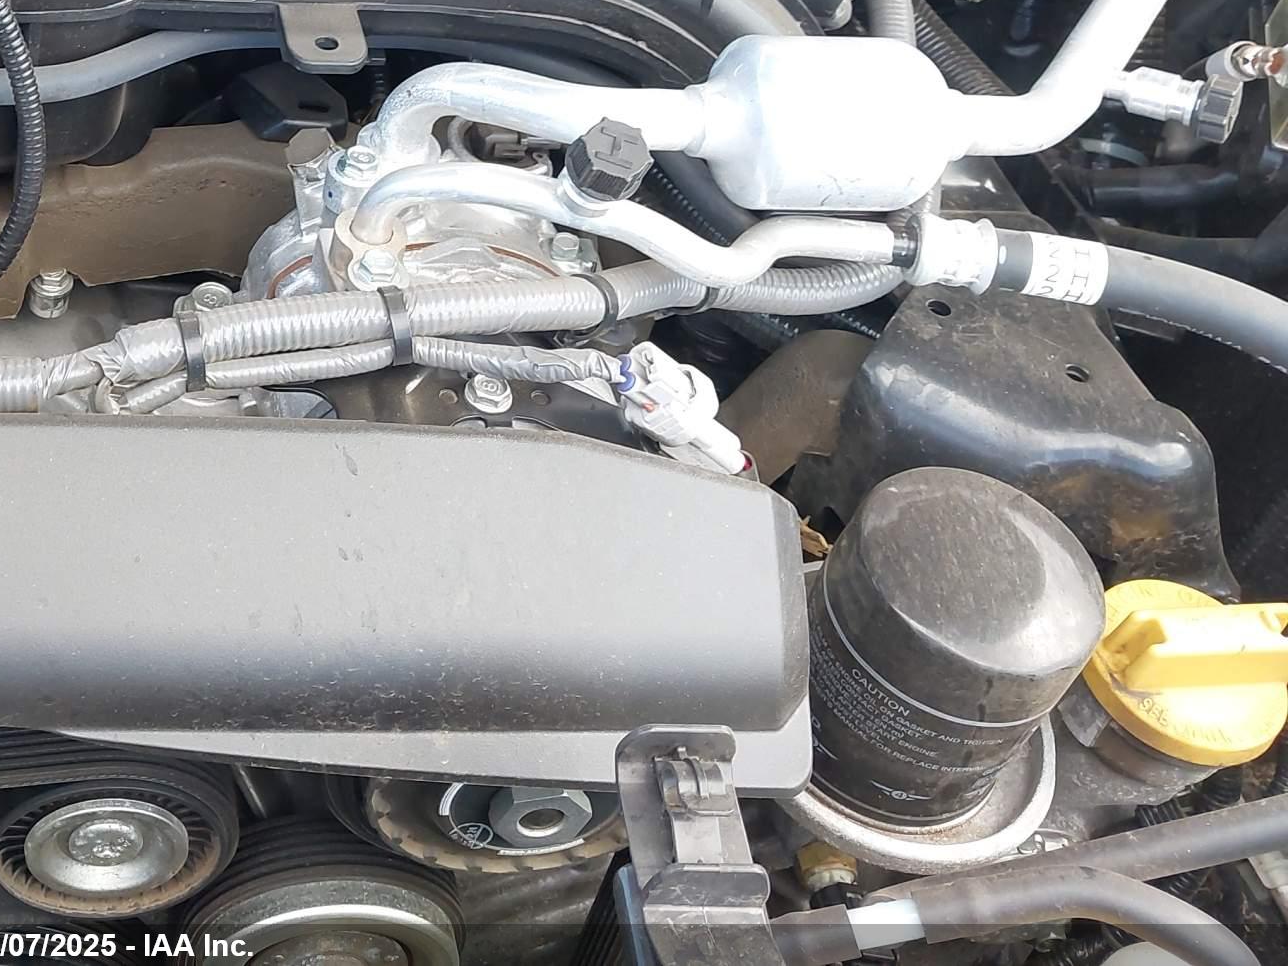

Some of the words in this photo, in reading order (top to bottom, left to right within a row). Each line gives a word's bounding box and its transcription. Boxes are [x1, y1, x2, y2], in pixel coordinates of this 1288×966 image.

[851, 668, 911, 716] CAUTION
[878, 705, 895, 718] ON
[895, 716, 938, 737] GASKET
[938, 734, 961, 743] AND
[870, 739, 892, 754] FOR
[892, 751, 940, 770] REPLACE
